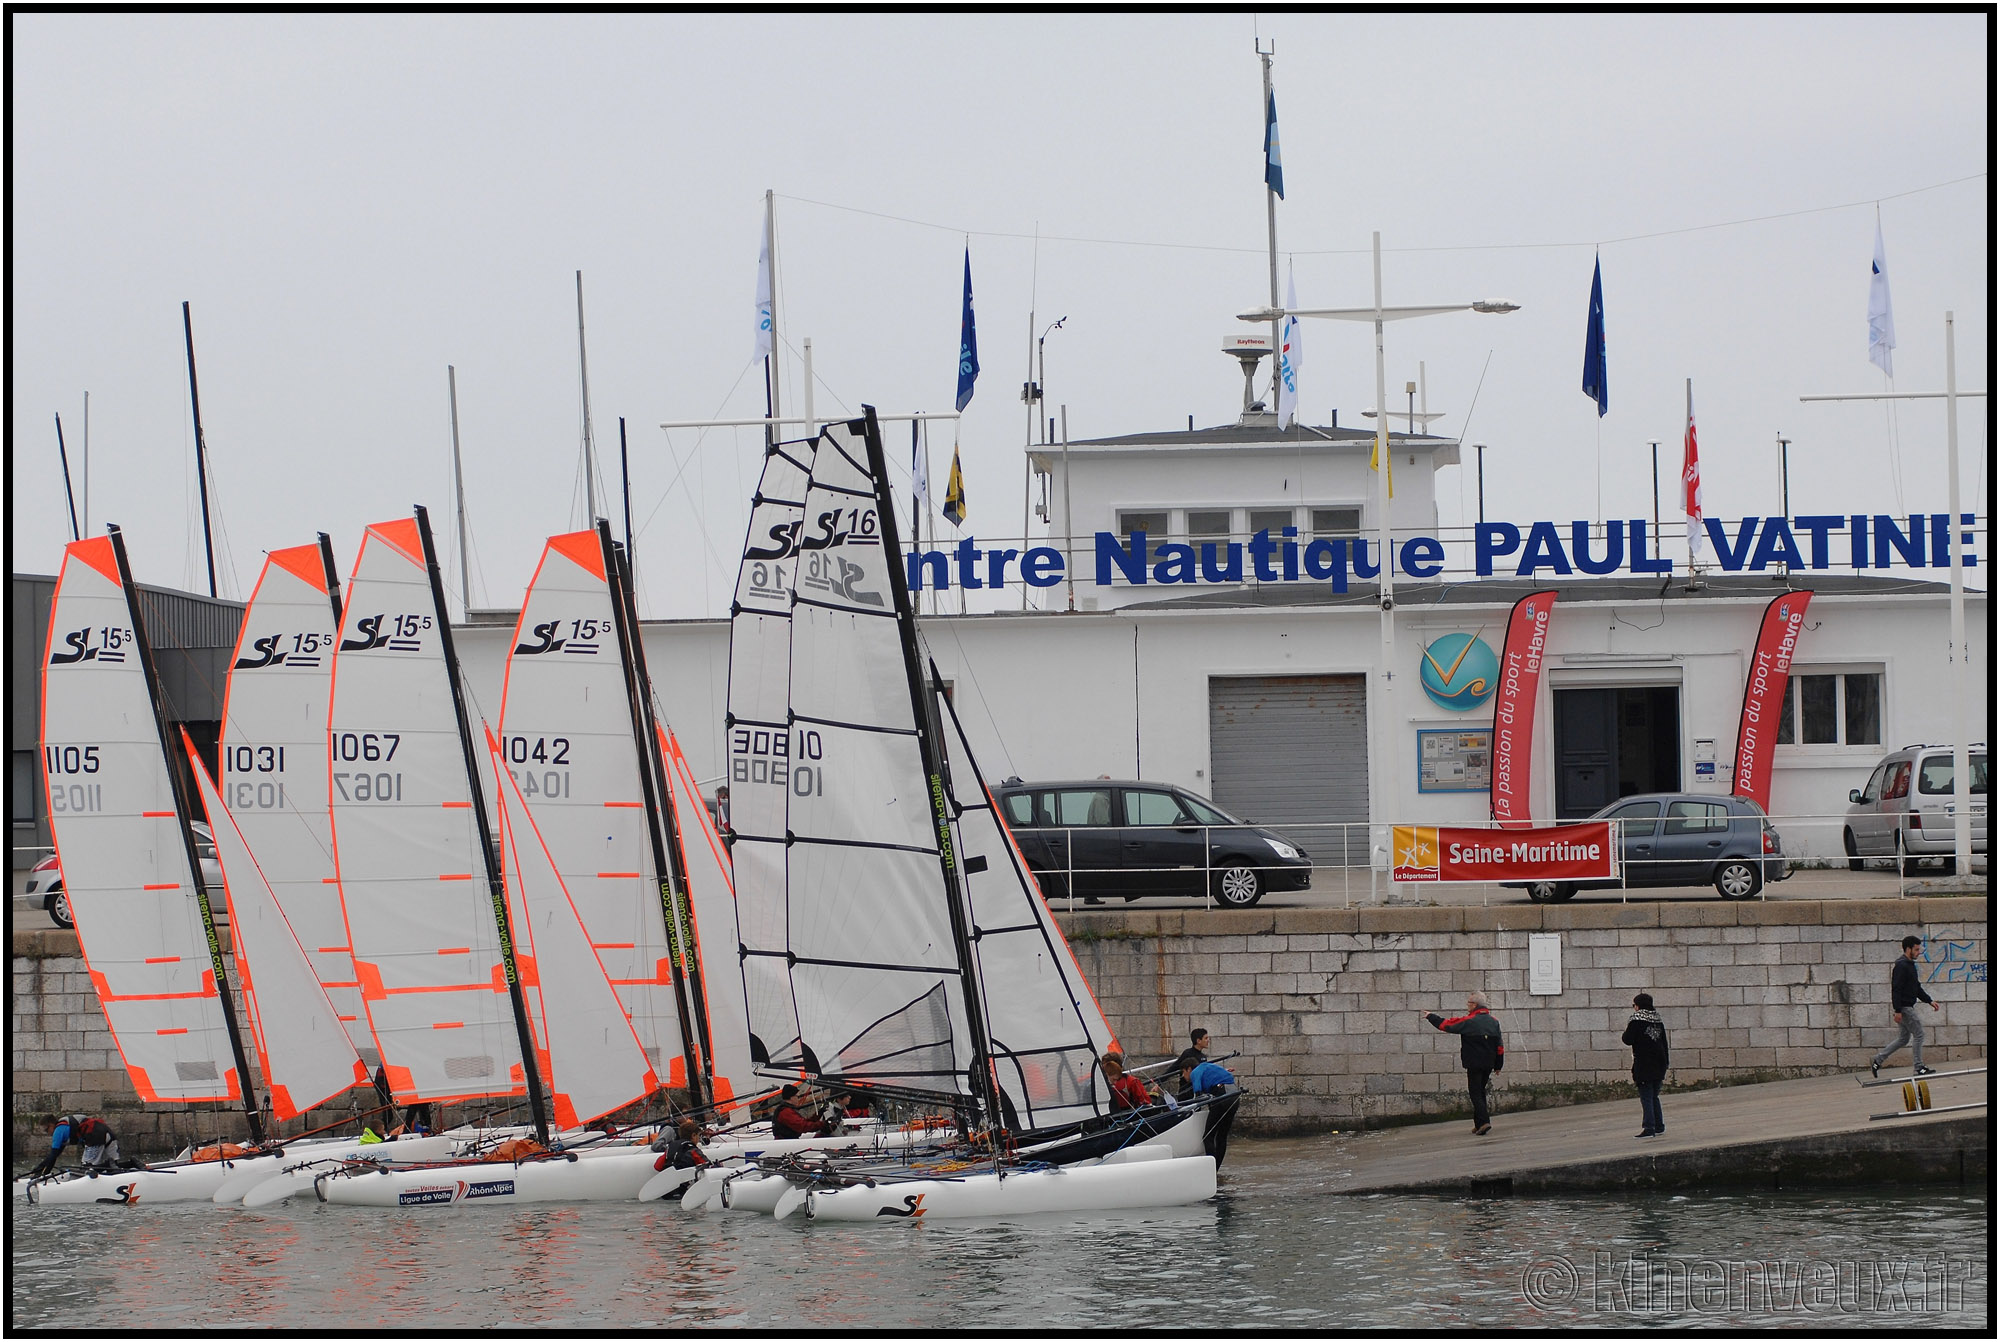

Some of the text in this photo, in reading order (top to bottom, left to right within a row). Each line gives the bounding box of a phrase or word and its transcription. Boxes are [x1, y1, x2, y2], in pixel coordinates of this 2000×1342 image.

[848, 508, 877, 535] 16
[1095, 526, 1445, 594] Nautique
[1475, 519, 1673, 576] PAUL
[1703, 513, 1977, 571] VATINE
[1524, 611, 1548, 674] leHavre
[1773, 612, 1802, 674] leHavre
[332, 733, 401, 762] 1067
[502, 736, 570, 765] 1042
[799, 729, 823, 760] 10
[1496, 651, 1522, 818] La passion du sport
[1739, 650, 1772, 792] passion du sport
[46, 746, 100, 774] 1105
[227, 746, 285, 772] 1031
[930, 774, 955, 869] sirena-voile.com
[1449, 840, 1600, 864] Seine-Maritime
[197, 893, 225, 981] sirena-voile.com
[493, 894, 517, 983] sirena-voile.com
[661, 882, 682, 968] sirena-voile.com
[676, 892, 696, 972] sirena-voile.com
[400, 1195, 421, 1204] Ligue
[433, 1192, 451, 1201] Voile
[876, 1193, 928, 1217] SL
